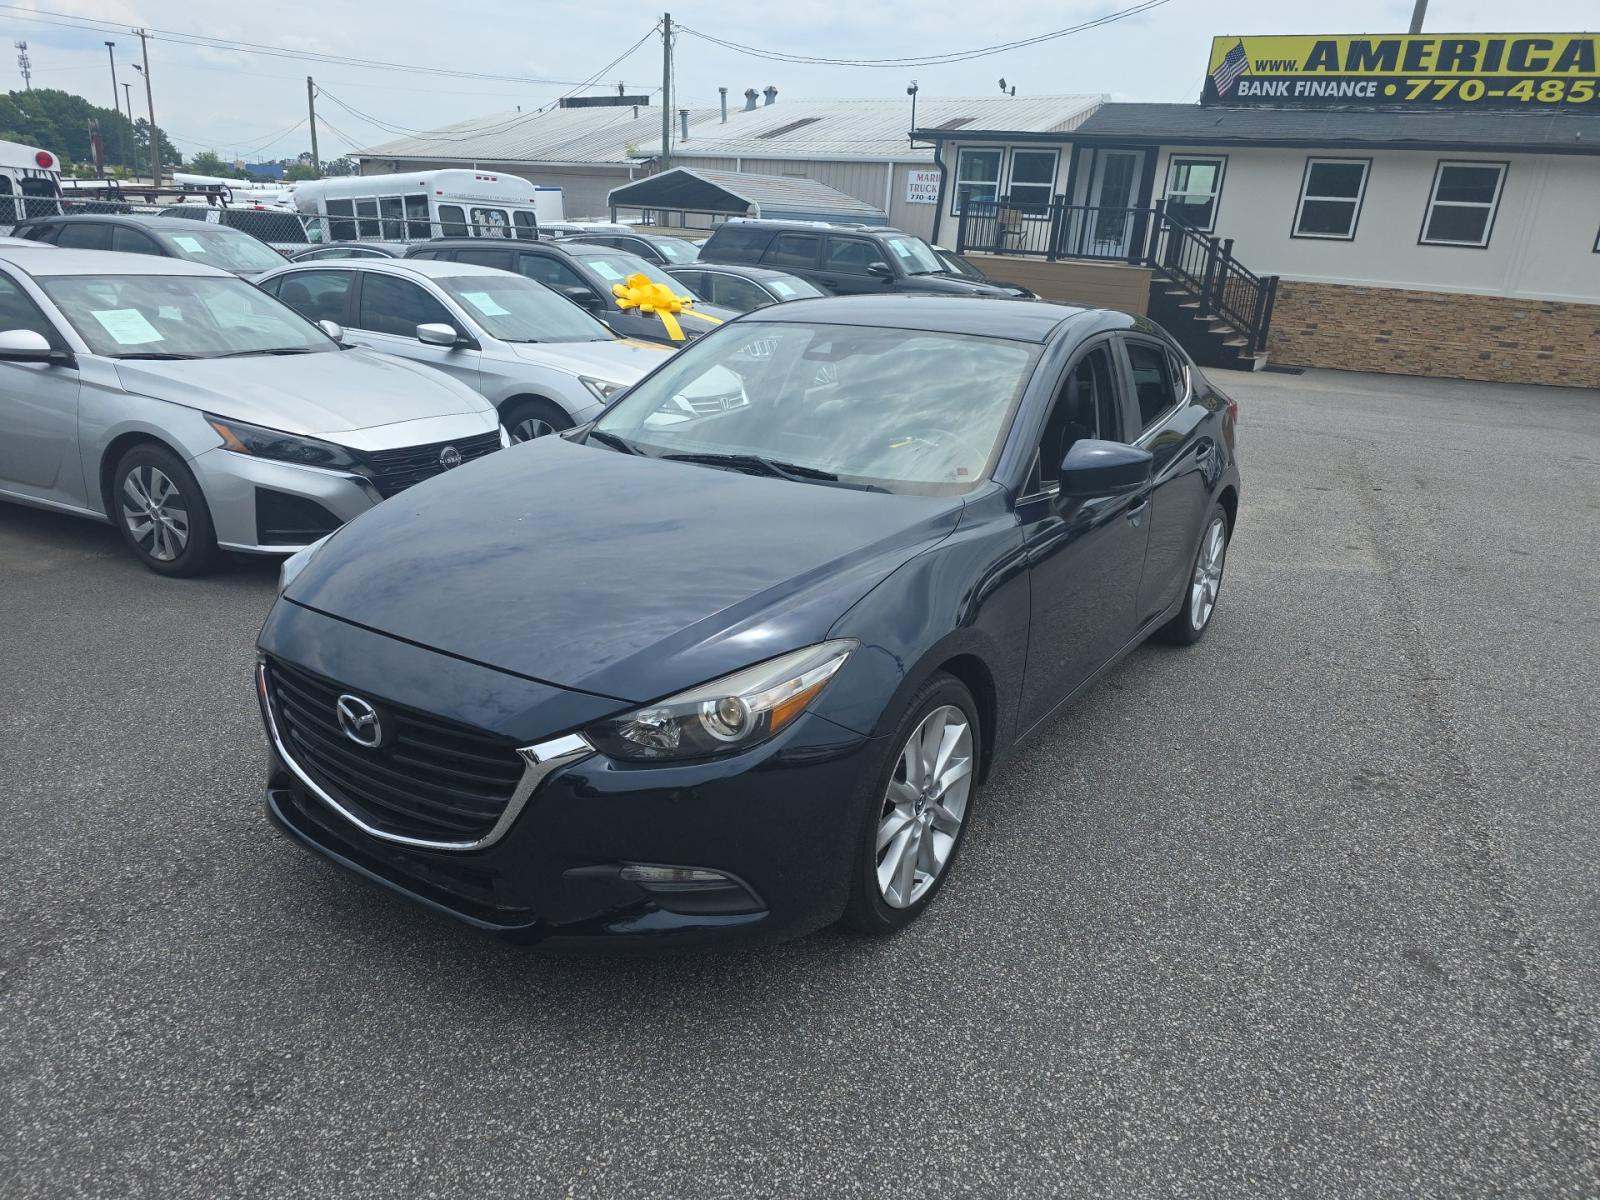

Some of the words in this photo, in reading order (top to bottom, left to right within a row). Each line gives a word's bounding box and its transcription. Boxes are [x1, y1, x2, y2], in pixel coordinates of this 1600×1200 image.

[1238, 81, 1290, 97] BANK
[1294, 81, 1378, 98] FINANCE
[1404, 80, 1600, 103] 770-485
[909, 183, 937, 193] TRUCK
